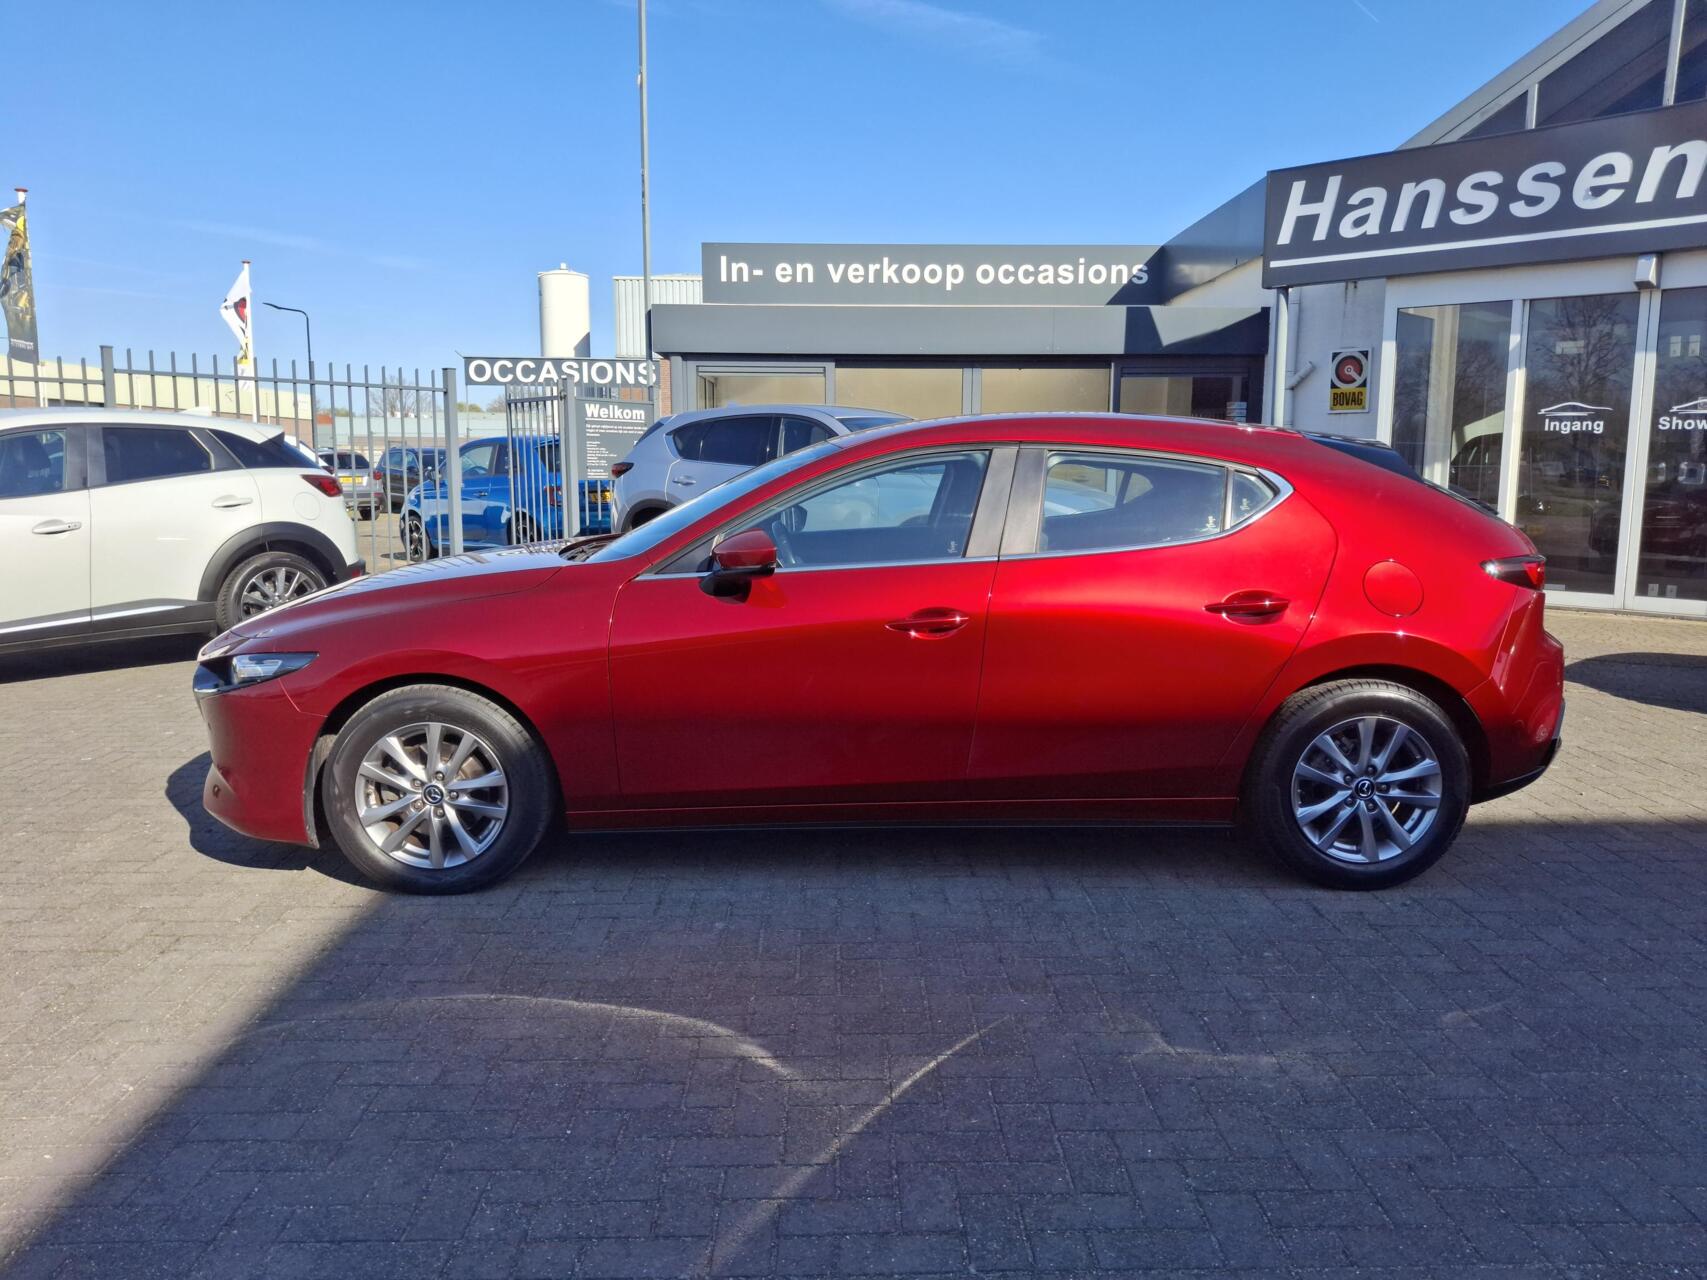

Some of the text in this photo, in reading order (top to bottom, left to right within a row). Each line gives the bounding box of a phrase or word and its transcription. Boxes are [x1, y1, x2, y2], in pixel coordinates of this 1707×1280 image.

[1277, 139, 1707, 245] Hanssen
[720, 255, 1149, 291] In- en verkoop occasions
[468, 359, 657, 385] OCCASIONS
[1332, 391, 1364, 407] BOVAG
[585, 403, 646, 420] Welkom
[1544, 418, 1604, 434] Ingang
